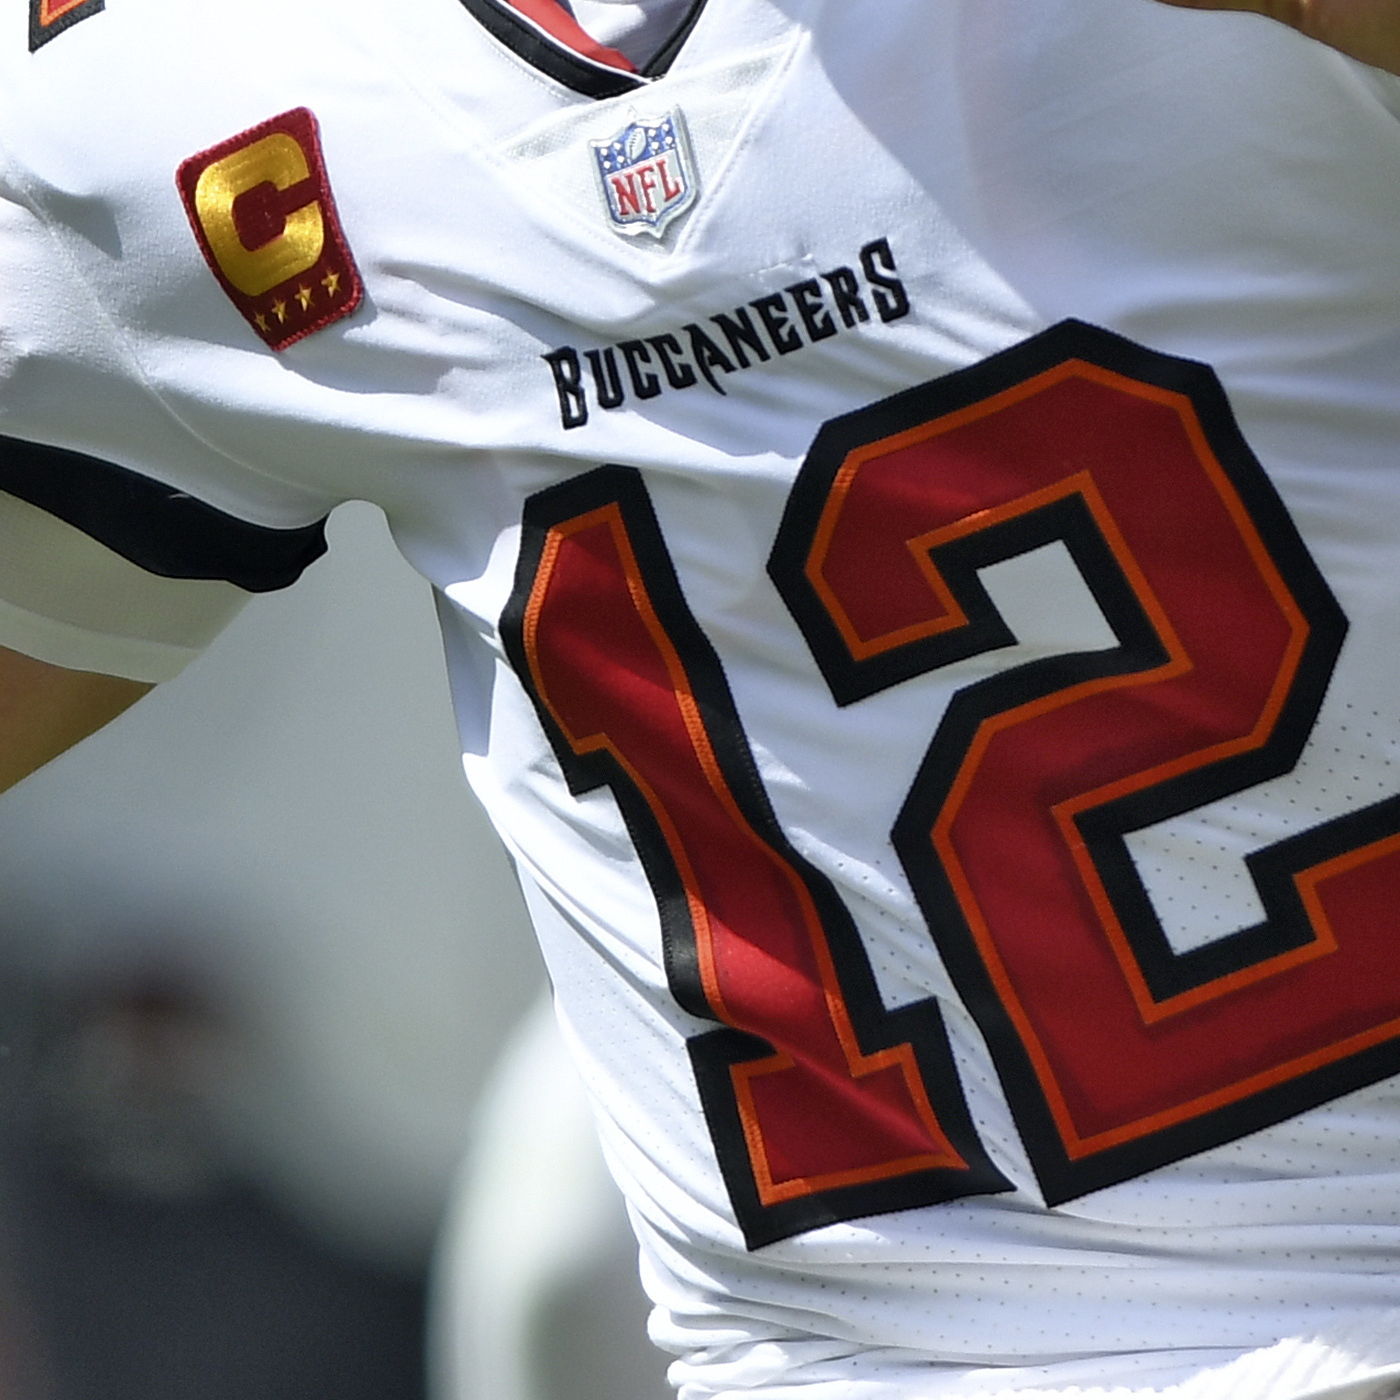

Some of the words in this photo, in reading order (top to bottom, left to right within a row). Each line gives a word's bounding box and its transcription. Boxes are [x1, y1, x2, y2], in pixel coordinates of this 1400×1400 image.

[194, 131, 325, 297] C
[610, 157, 684, 217] NFL
[540, 235, 911, 431] BUCCANEERS
